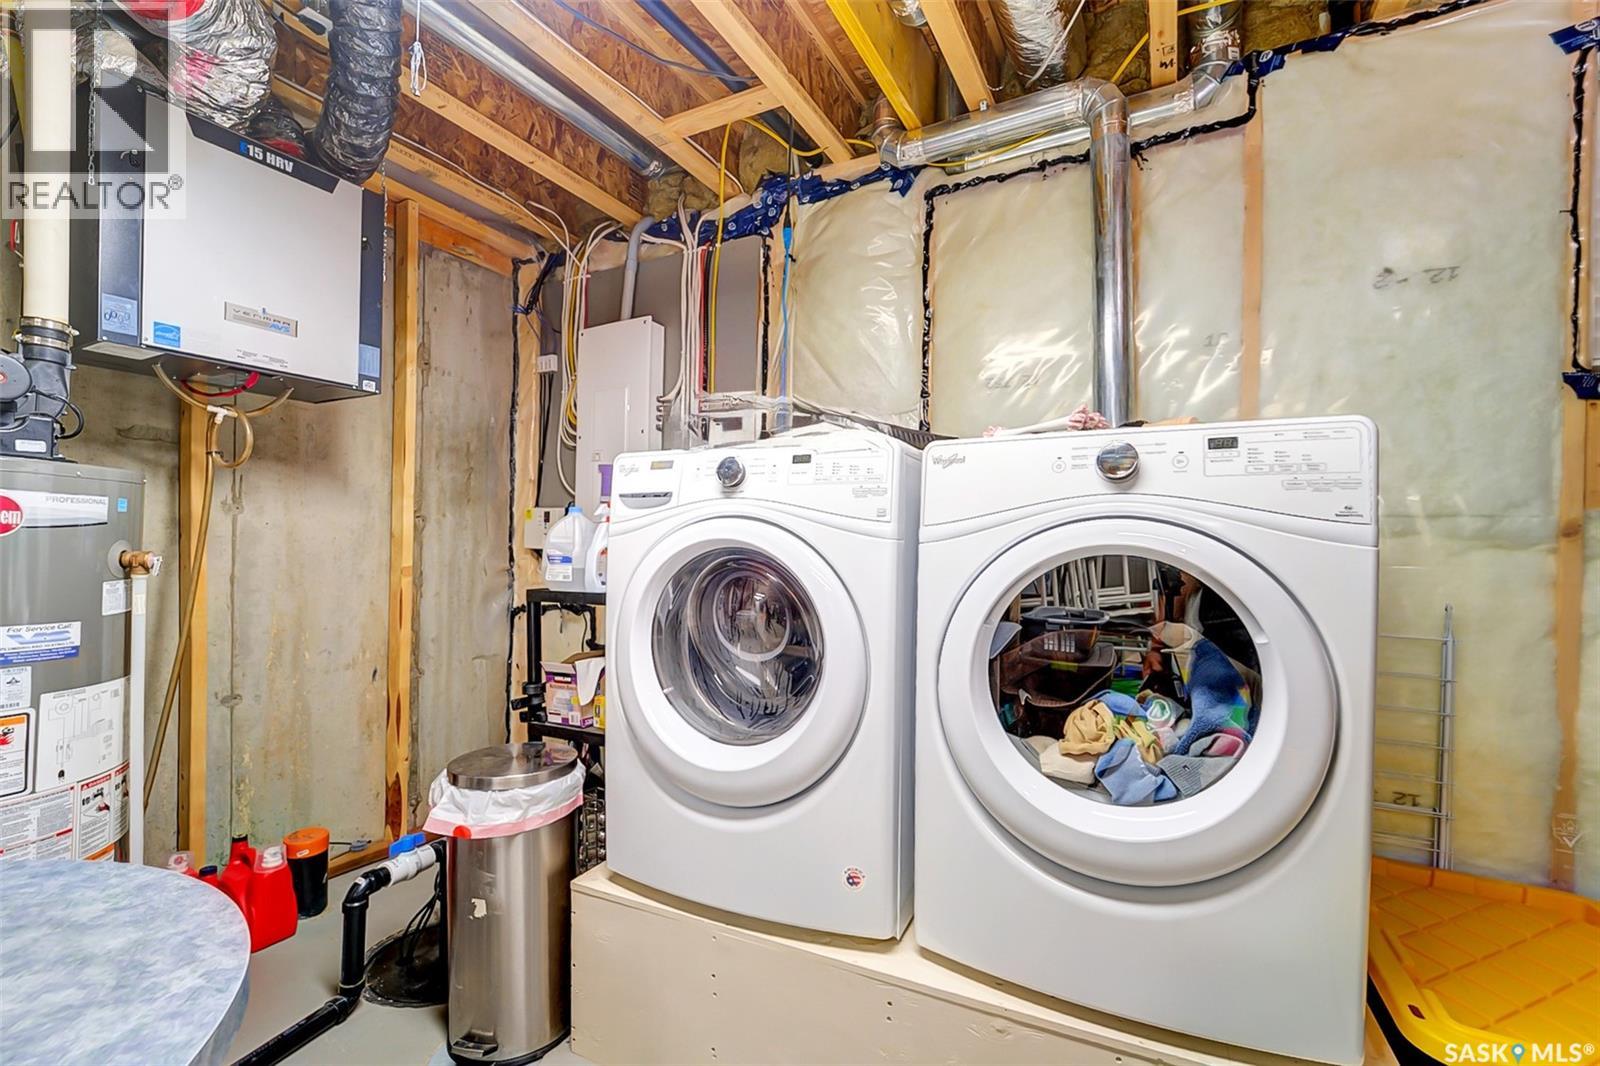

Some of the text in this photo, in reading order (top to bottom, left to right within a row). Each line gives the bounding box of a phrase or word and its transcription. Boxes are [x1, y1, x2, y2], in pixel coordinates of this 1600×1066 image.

[266, 151, 294, 173] HRV
[45, 495, 107, 506] PROFESSIONAL
[26, 625, 56, 633] Service
